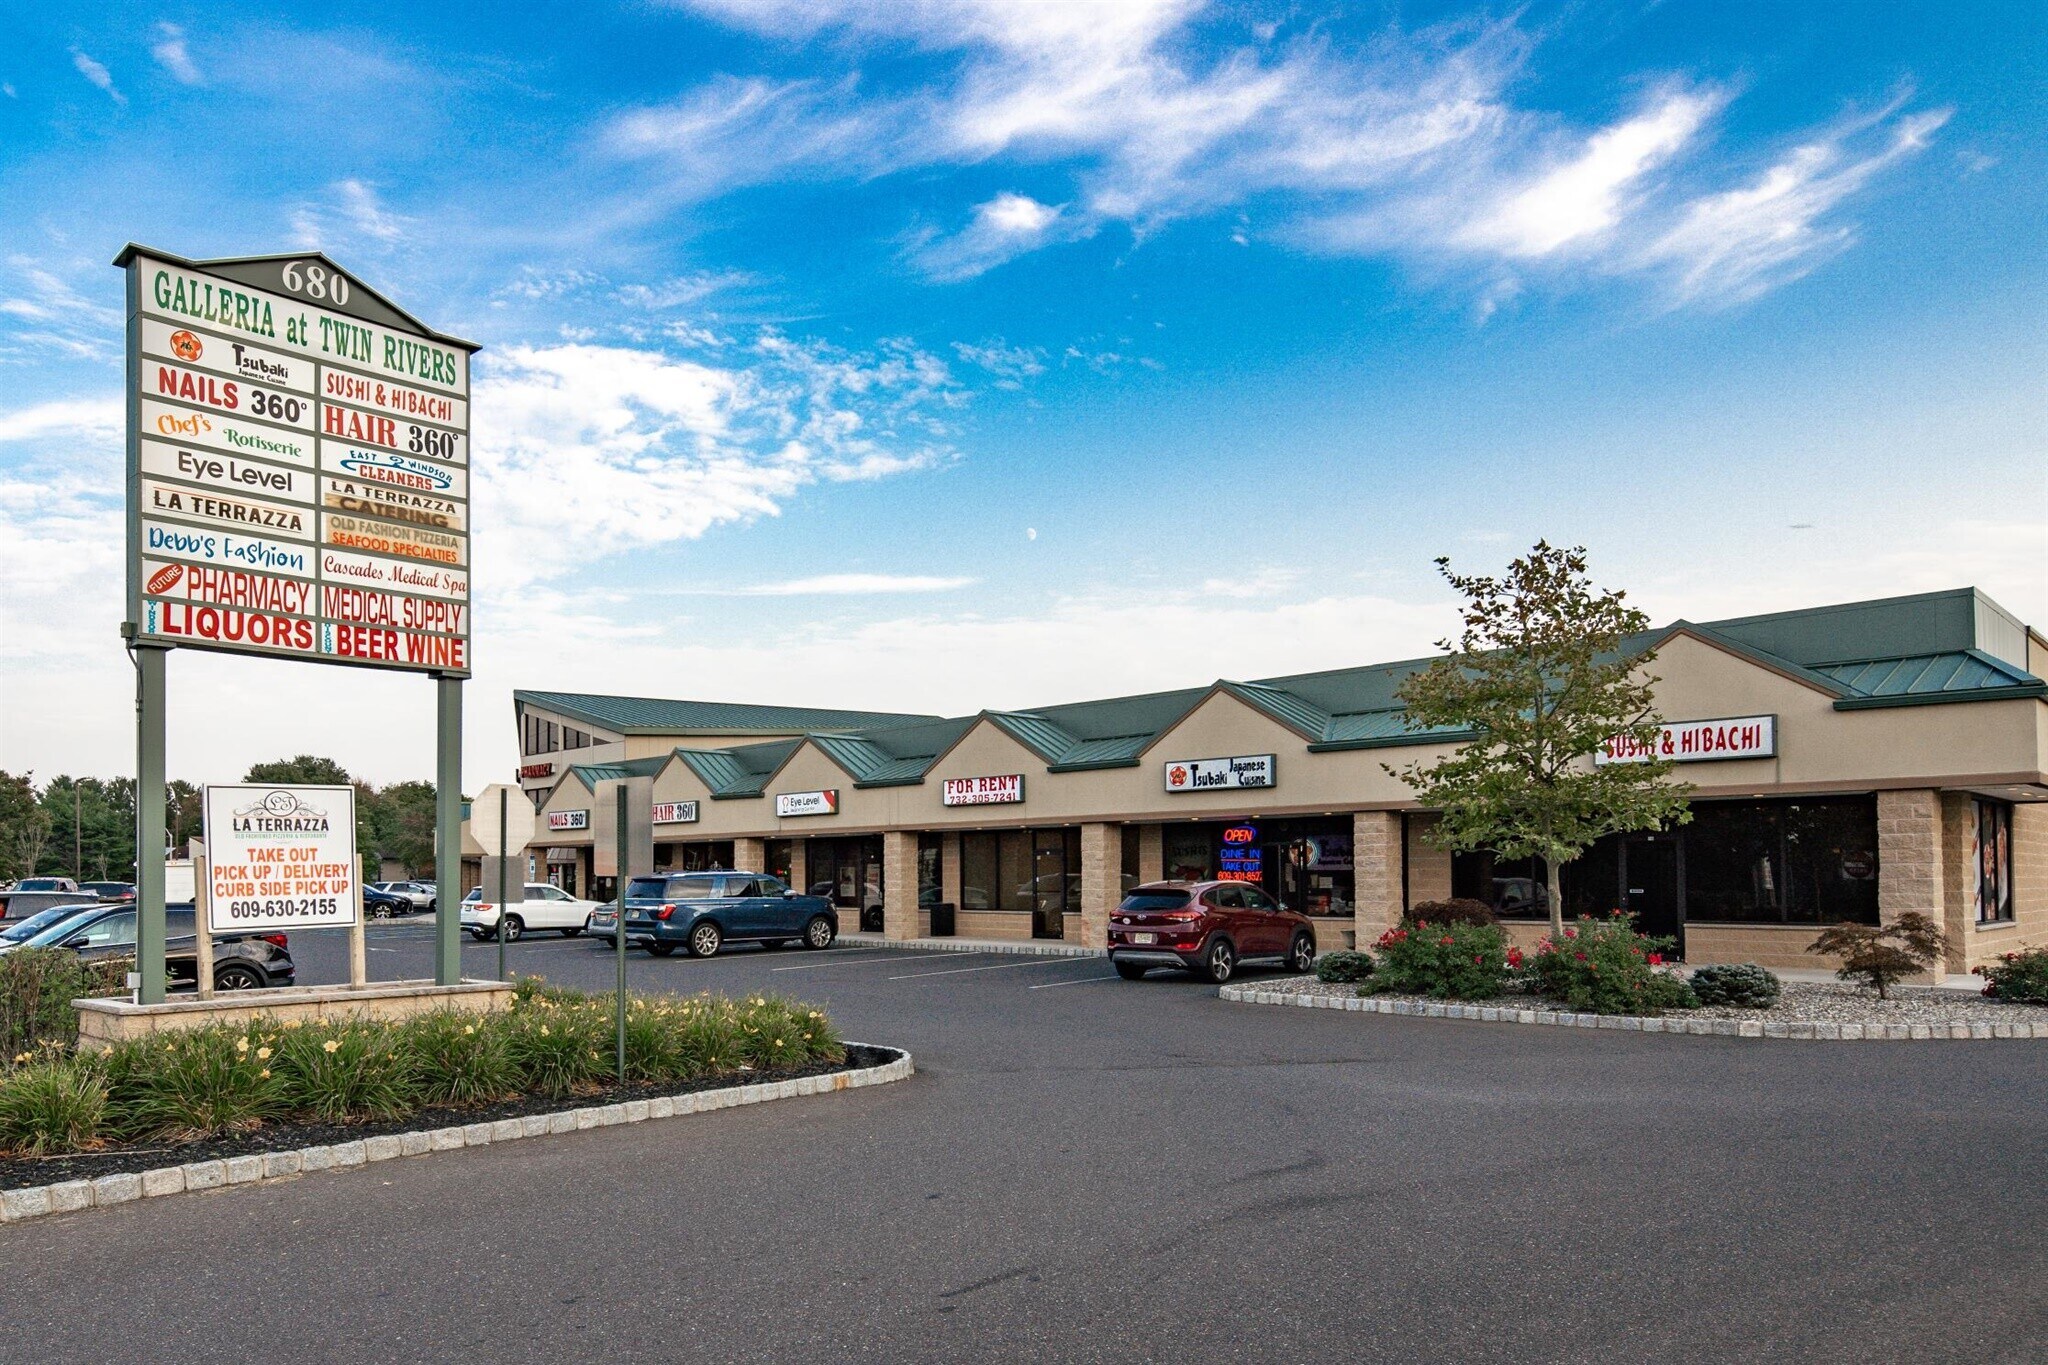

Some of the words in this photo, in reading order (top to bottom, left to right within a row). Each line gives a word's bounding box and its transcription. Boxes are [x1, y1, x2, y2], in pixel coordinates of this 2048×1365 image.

[282, 261, 349, 305] 680
[155, 270, 275, 338] GALLERIA
[287, 313, 308, 346] at
[319, 315, 373, 364] TWIN
[383, 334, 456, 386] RIVERS
[232, 343, 288, 378] Tsubaki
[159, 366, 239, 409] NAILS
[251, 390, 307, 423] 360°
[327, 372, 370, 401] SUSHI
[375, 384, 386, 406] &
[392, 389, 452, 420] HIBACHI
[158, 414, 212, 436] Chef's
[324, 404, 398, 448] HAIR
[408, 425, 459, 459] 360°
[222, 428, 302, 457] Rotisserie
[178, 450, 224, 479] Eye
[230, 460, 292, 491] Level
[350, 450, 377, 461] EAST
[408, 460, 453, 483] WINDSOR
[360, 464, 433, 491] CLEANERS
[153, 490, 182, 510] LA
[191, 496, 302, 531] TERRAZZA
[331, 481, 356, 495] LA
[362, 486, 456, 514] TERRAZZA
[340, 496, 449, 528] CATERING
[331, 516, 355, 529] OLD
[359, 521, 410, 540] FASHION
[413, 532, 458, 549] PIZZERIA
[332, 531, 390, 552] SEAFOOD
[393, 541, 457, 563] SPECIALTIES
[149, 526, 216, 558] Debb's
[224, 538, 303, 571] Fashion
[149, 565, 182, 593] FUTURE
[188, 565, 310, 615] PHARMACY
[324, 555, 383, 580] Cascades
[388, 565, 440, 588] Medical
[442, 573, 466, 595] Spa
[163, 602, 313, 649] LIQUORS
[324, 586, 398, 627] MEDICAL
[403, 597, 462, 634] SUPPLY
[337, 624, 399, 661] BEER
[405, 633, 464, 668] WINE
[1661, 730, 1675, 755] &
[1681, 724, 1761, 754] HIBACHI
[1190, 764, 1228, 787] Tsubaki
[1229, 758, 1265, 774] Japanese
[947, 779, 973, 794] FOR
[979, 775, 1018, 792] RENT
[949, 793, 1016, 805] 732-305-7241
[653, 803, 674, 821] HAIR
[790, 797, 802, 807] Eye
[802, 796, 819, 806] Level
[233, 818, 251, 831] LA
[256, 818, 329, 832] TERRAZZA
[550, 813, 568, 827] NAILS
[1224, 829, 1253, 842] OPEN
[247, 848, 285, 862] TAKE
[289, 848, 318, 862] OUT
[1220, 849, 1245, 859] DINE
[1249, 849, 1260, 859] IN
[1221, 861, 1240, 871] TAKE
[1243, 861, 1260, 871] OUT
[214, 865, 248, 880] PICK
[253, 865, 271, 879] UP
[275, 865, 280, 879] /
[283, 864, 349, 879] DELIVERY
[215, 882, 255, 897] CURB
[259, 881, 291, 896] SIDE
[295, 881, 328, 895] PICK
[331, 880, 349, 894] UP
[230, 898, 337, 919] 609-630-2155
